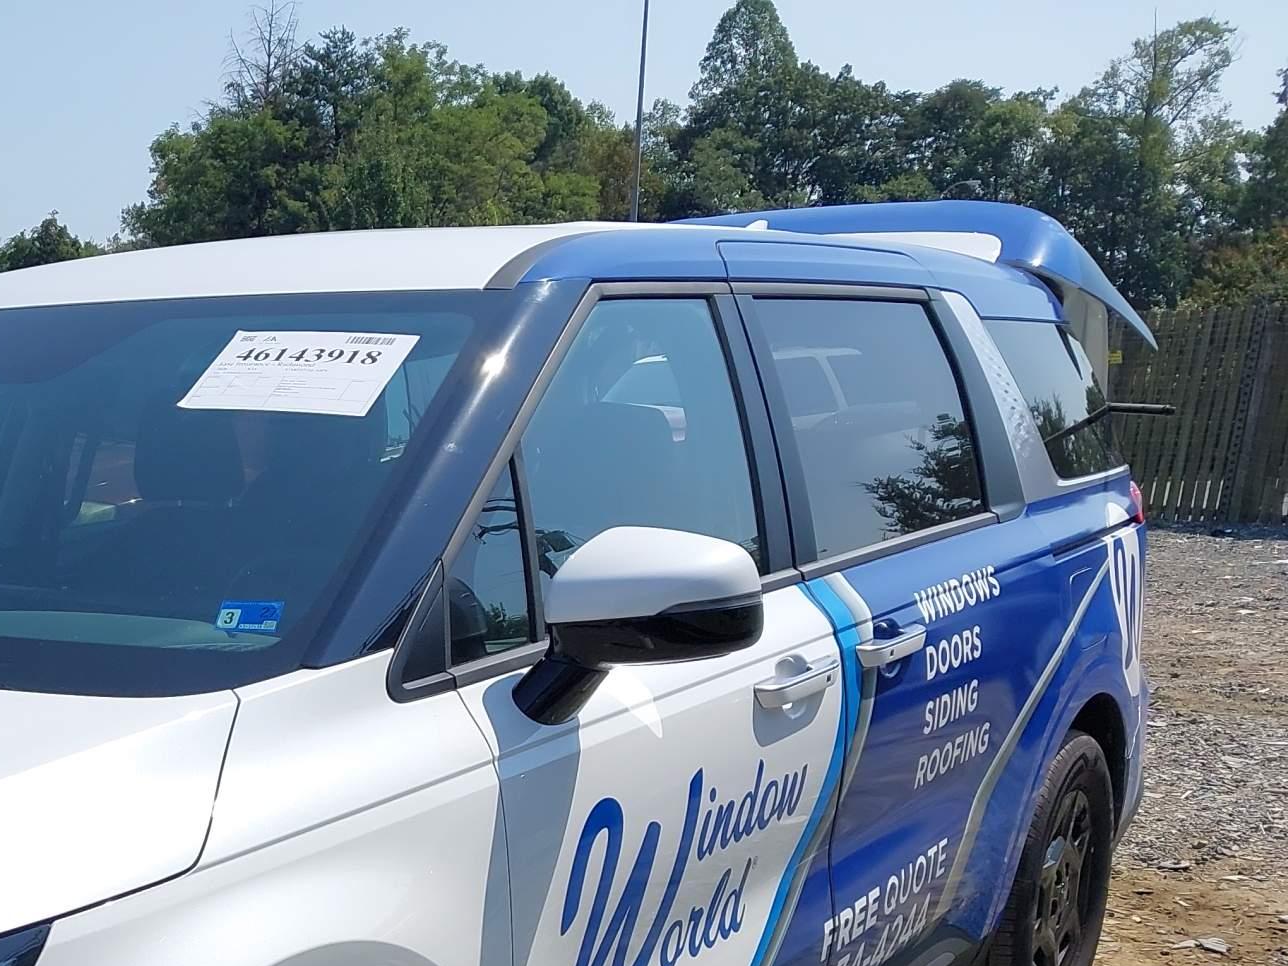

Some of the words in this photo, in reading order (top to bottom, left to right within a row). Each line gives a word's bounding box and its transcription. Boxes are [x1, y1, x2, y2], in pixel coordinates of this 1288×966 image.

[235, 346, 383, 366] 46143918
[223, 611, 235, 625] 3
[914, 565, 1001, 624] WINDOWS
[925, 625, 982, 681] DOORS
[922, 679, 979, 735] SIDING
[914, 722, 991, 790] ROOFING
[820, 886, 880, 963] FREE
[883, 837, 949, 913] QUOTE
